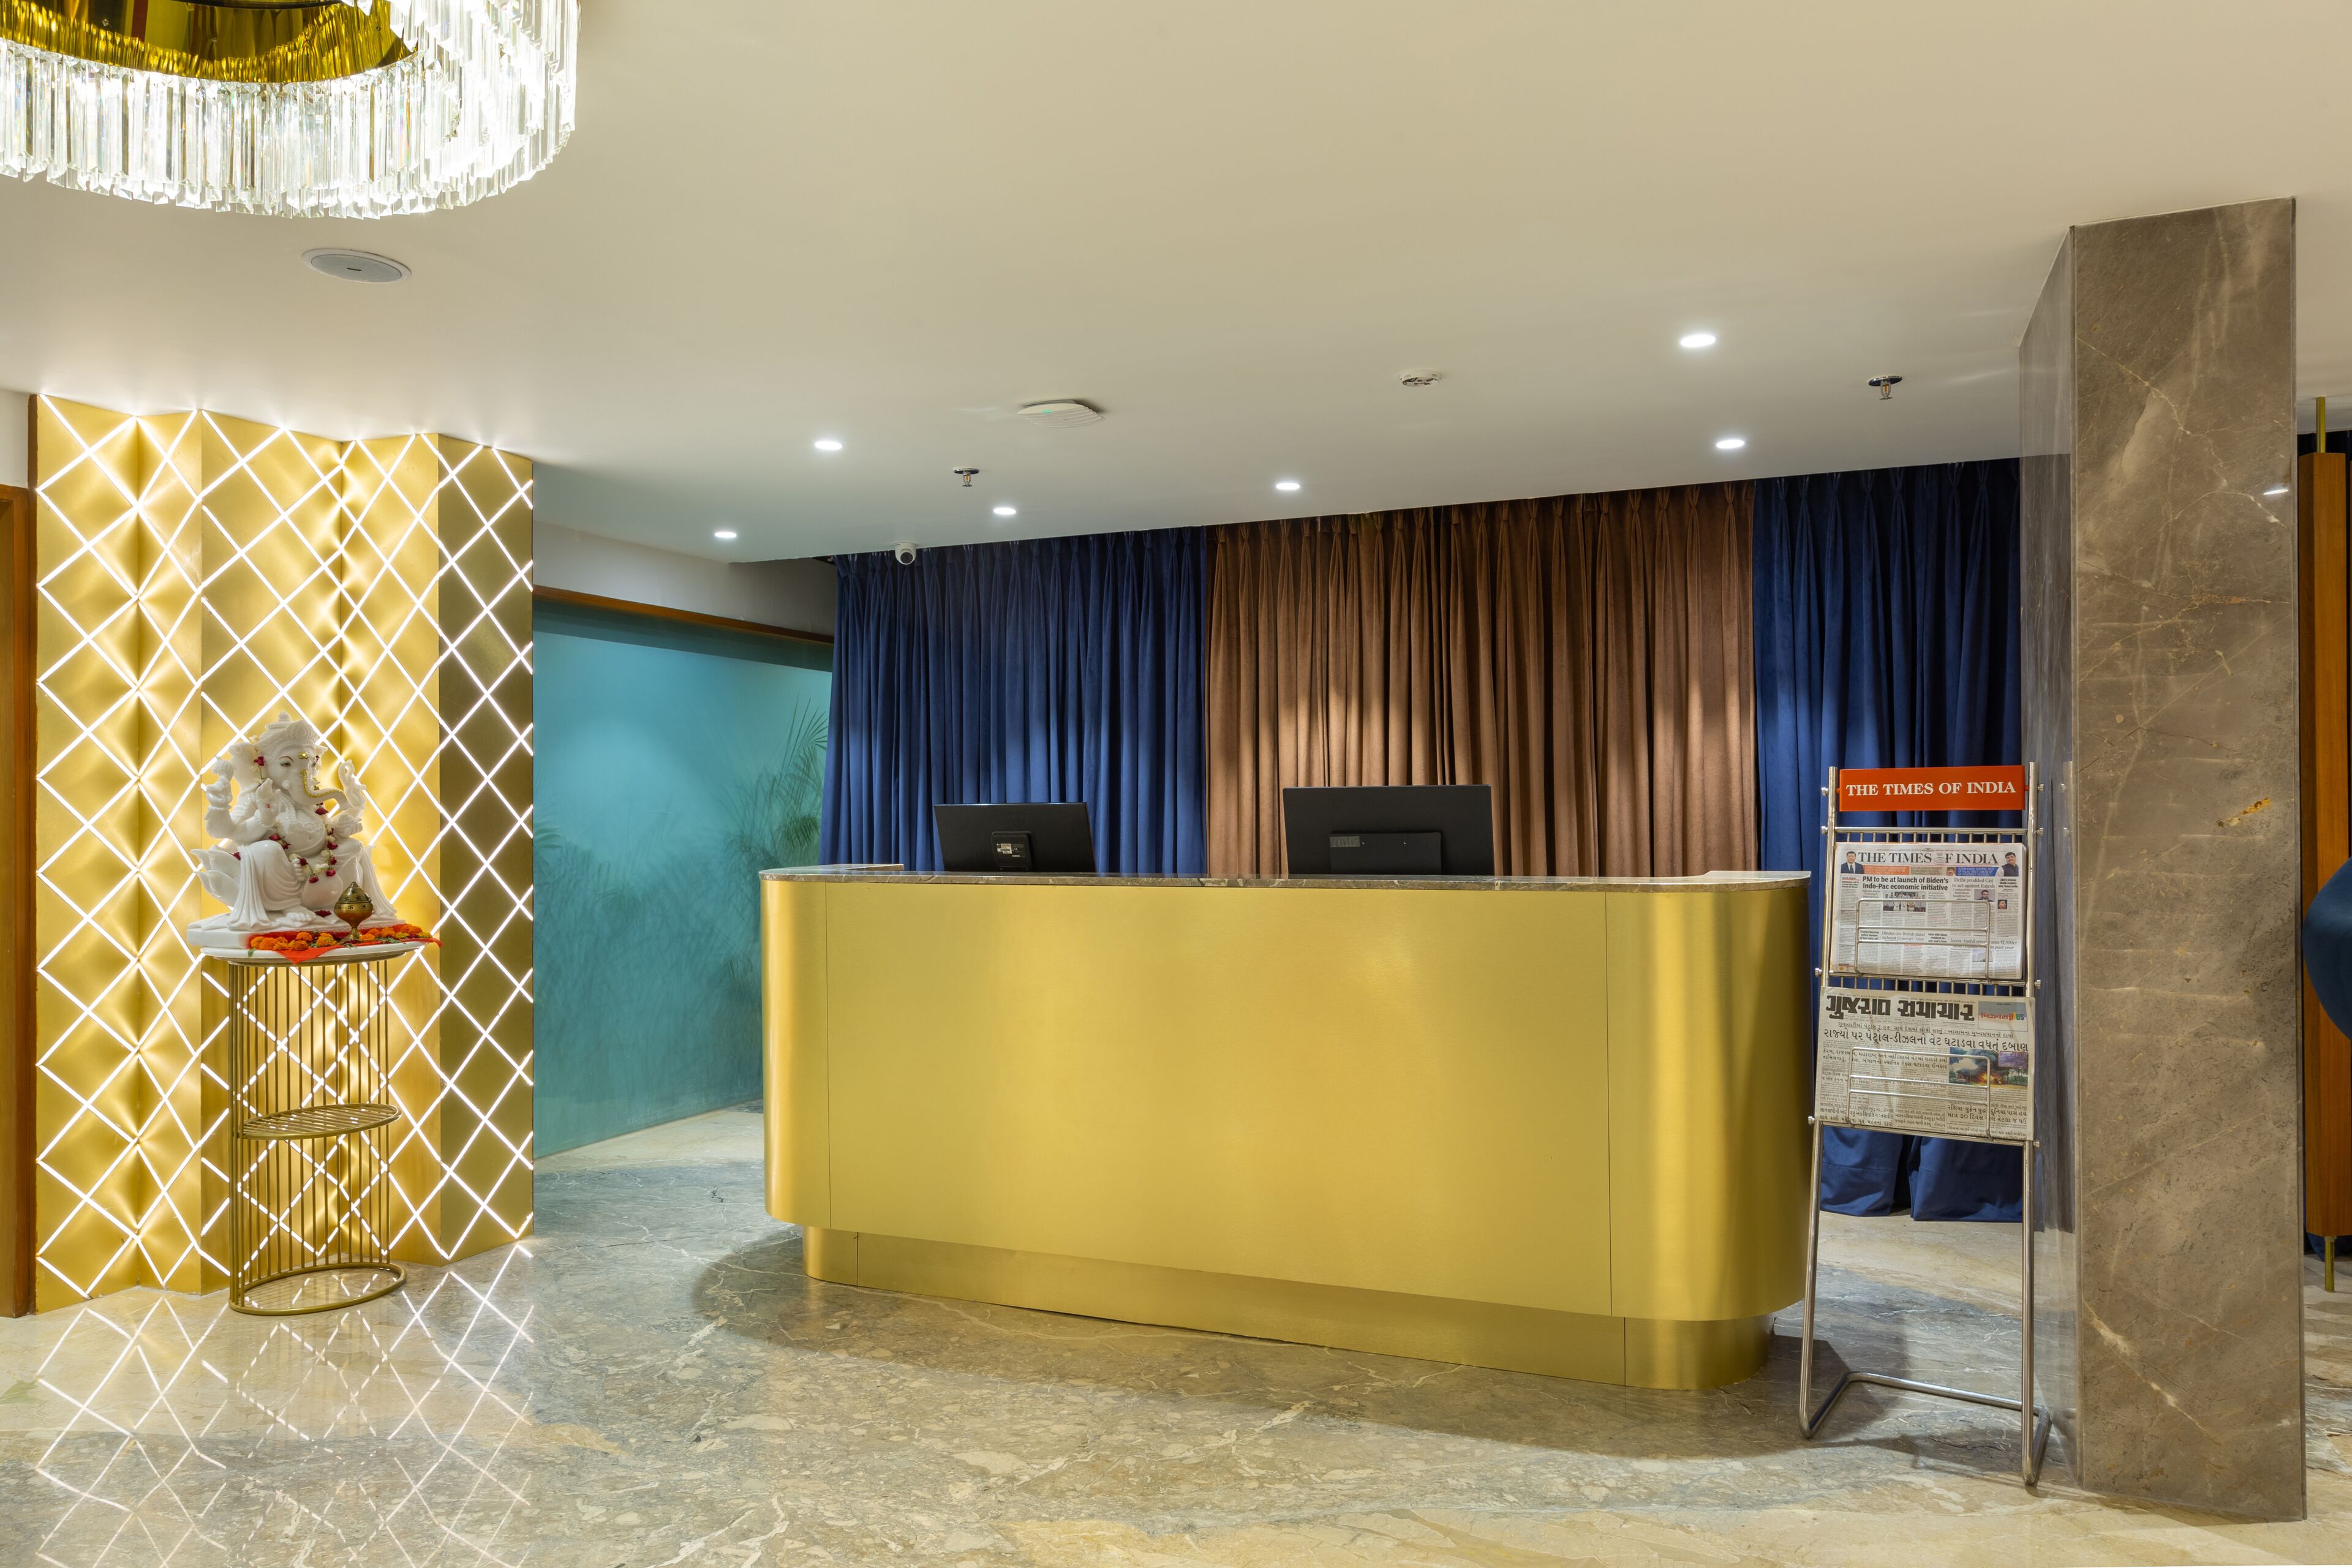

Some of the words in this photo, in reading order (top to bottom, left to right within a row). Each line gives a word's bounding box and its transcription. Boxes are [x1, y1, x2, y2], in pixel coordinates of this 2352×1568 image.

[1845, 784, 1879, 796] THE
[1882, 783, 1934, 796] TIMES
[1939, 782, 1962, 794] OF
[1967, 781, 2016, 794] INDIA
[1858, 852, 1887, 863] THE
[1889, 853, 1932, 864] TIMES
[1956, 853, 1999, 864] INDIA
[1826, 995, 1891, 1020] ગુજરાત
[1898, 1000, 1975, 1021] સમાચાર
[1824, 1027, 1849, 1039] રાજ્યો
[1852, 1031, 1863, 1041] પર
[1929, 1033, 1942, 1046] વેટ
[1944, 1038, 1976, 1048] ઘટાડવા
[1978, 1038, 1999, 1053] વધતું
[2002, 1042, 2029, 1052] દબાણ
